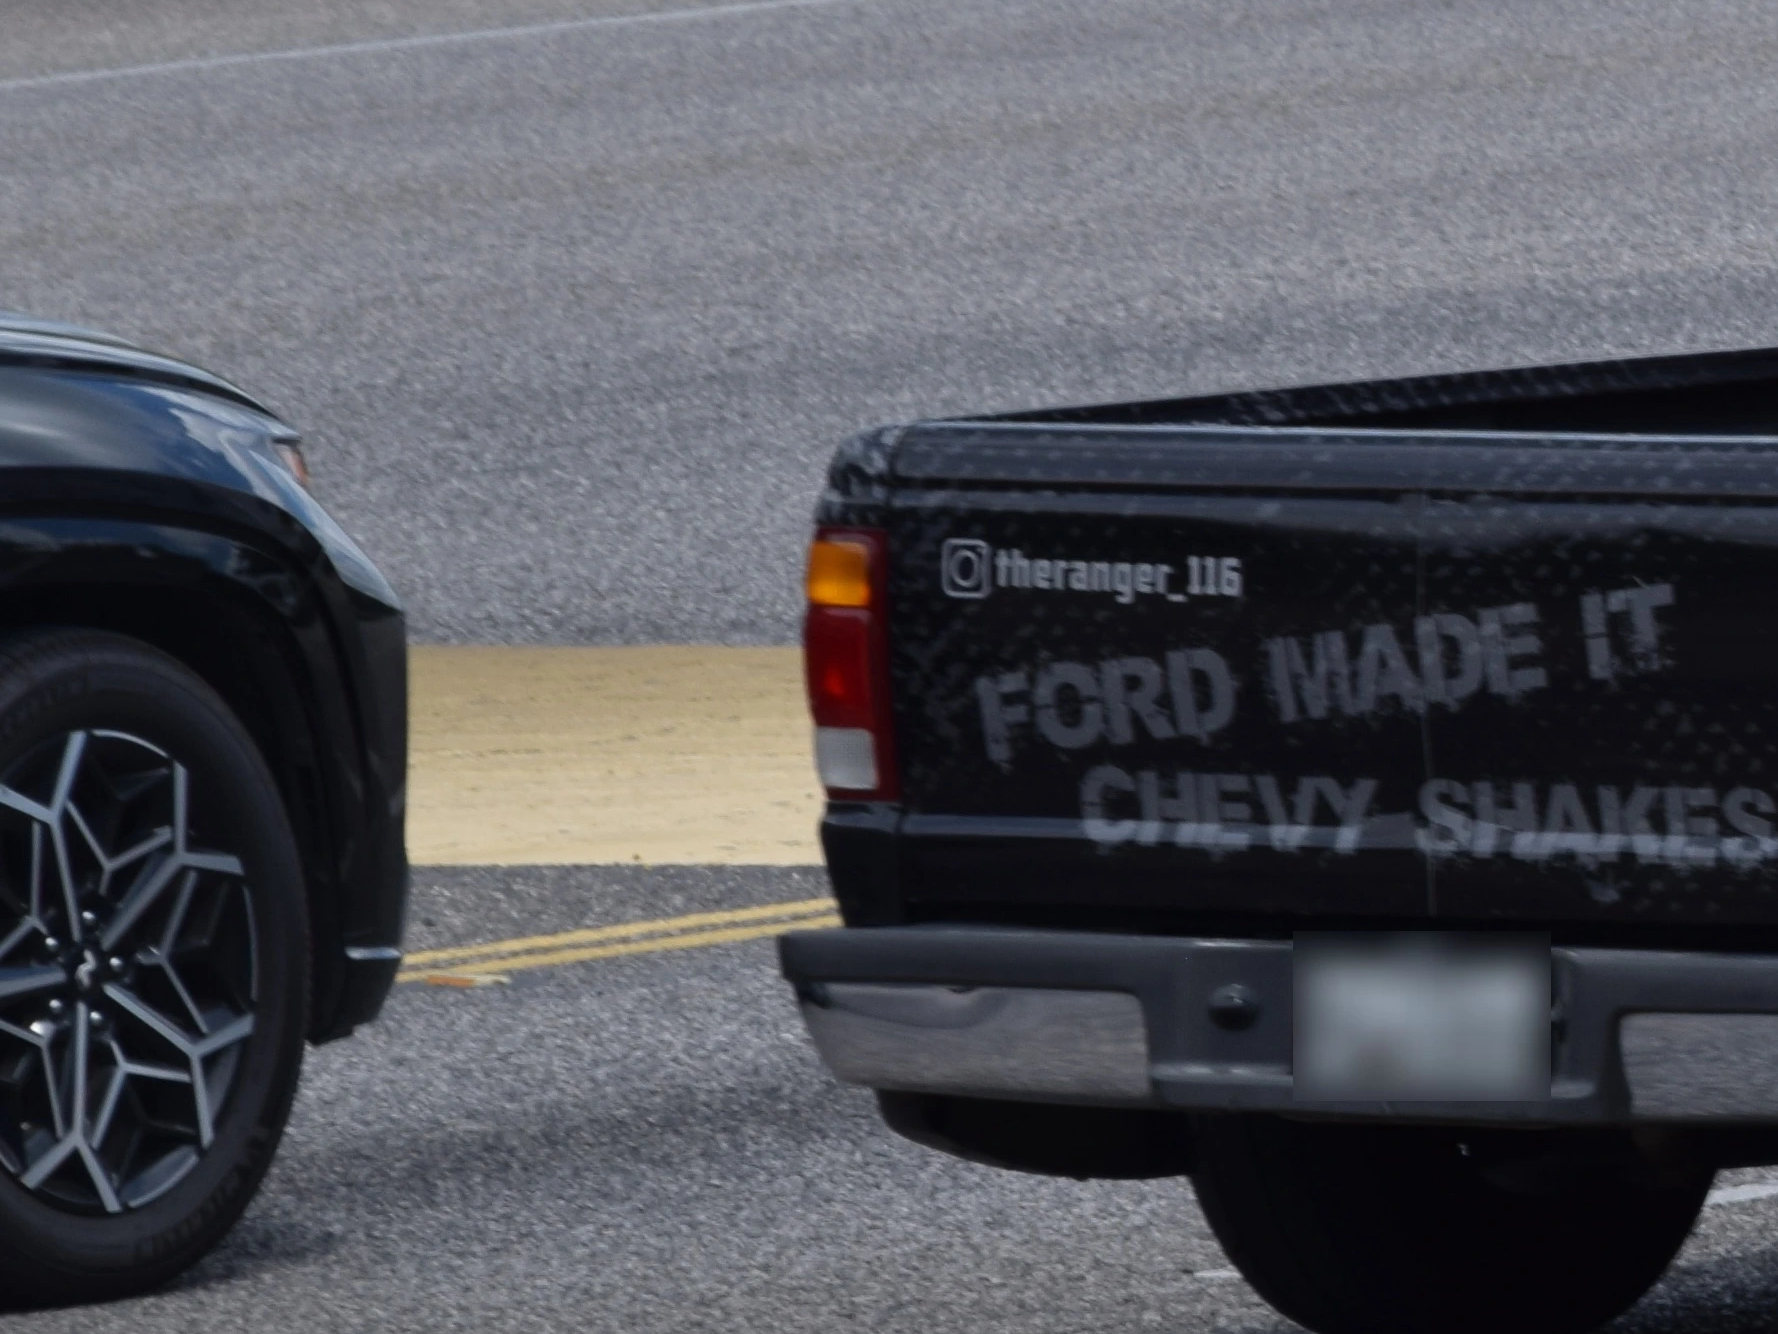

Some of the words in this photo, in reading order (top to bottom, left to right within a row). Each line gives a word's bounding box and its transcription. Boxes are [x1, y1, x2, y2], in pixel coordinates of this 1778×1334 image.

[995, 547, 1243, 604] theranger_116
[976, 649, 1236, 764] FORD
[1267, 602, 1545, 723] MADE
[1581, 579, 1675, 684] IT
[1080, 765, 1377, 853] CHEVY
[1413, 777, 1778, 866] SHAKES
